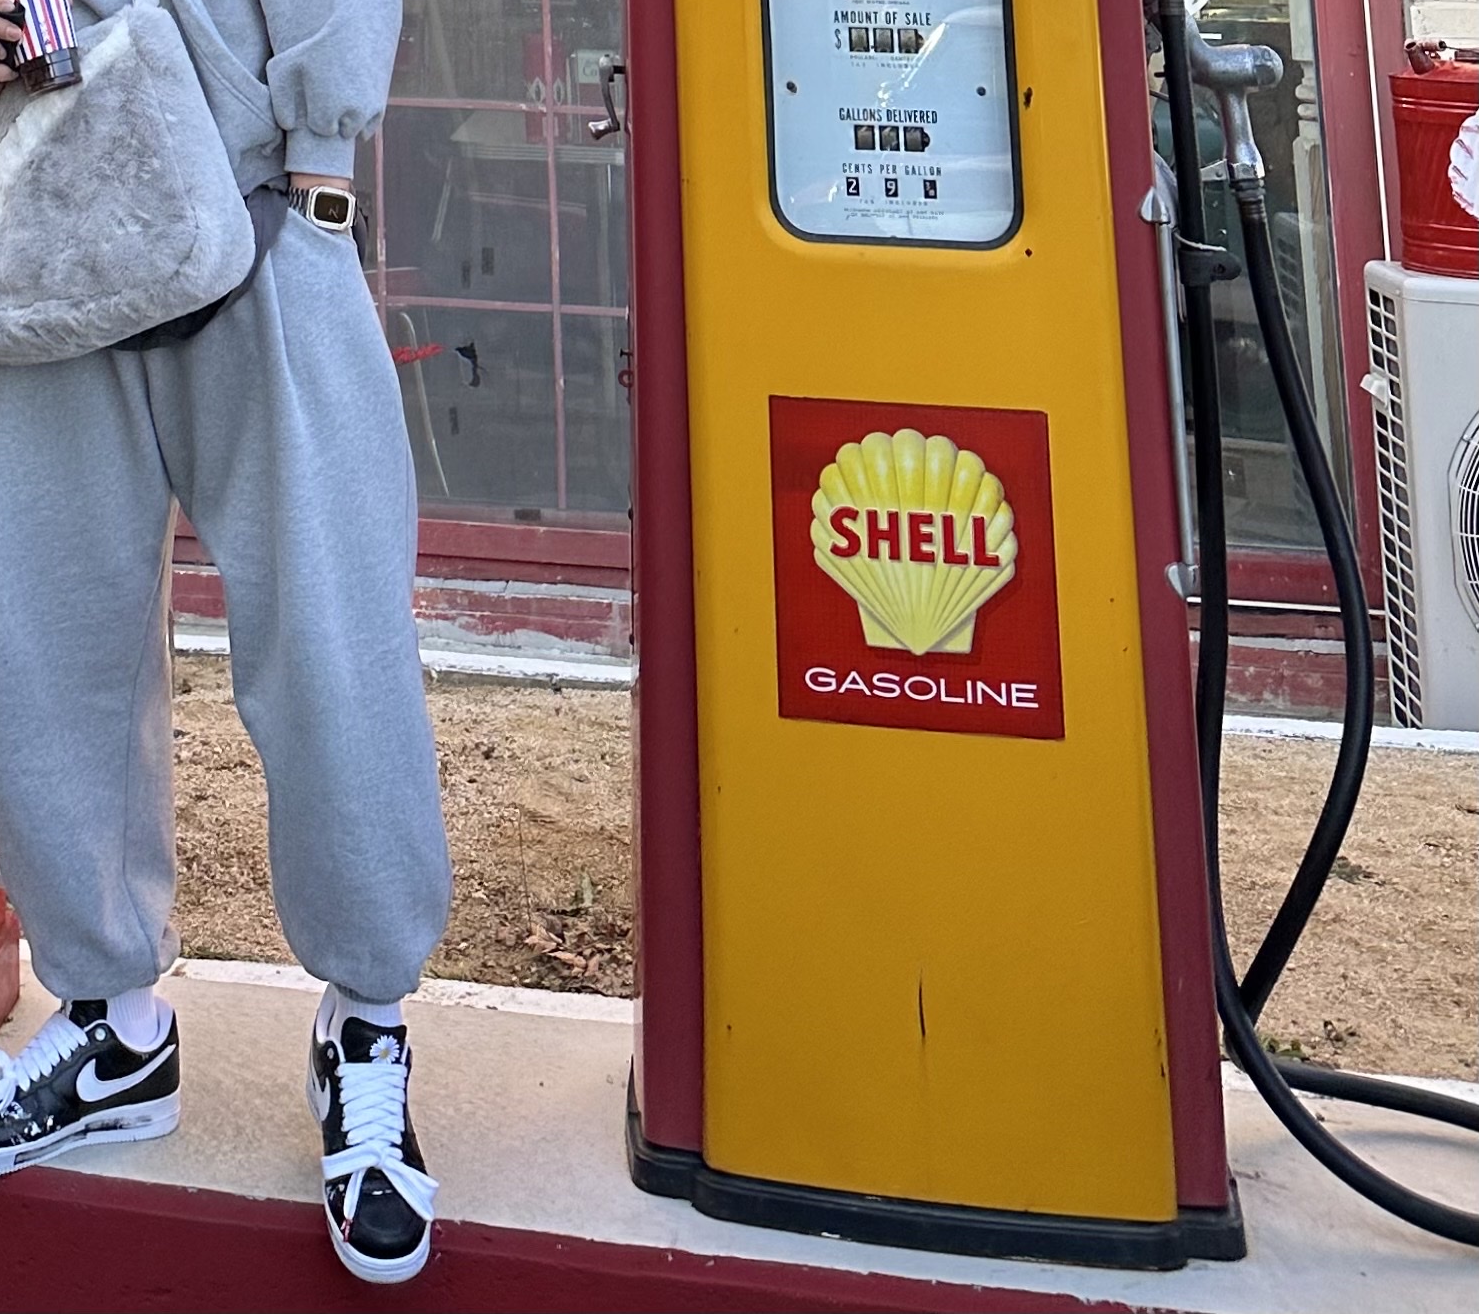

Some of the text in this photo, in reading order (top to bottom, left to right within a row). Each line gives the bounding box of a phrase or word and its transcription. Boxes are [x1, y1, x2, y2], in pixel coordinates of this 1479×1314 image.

[834, 10, 932, 27] AMOUNT OF SALE
[838, 107, 938, 124] GALLONS DELIVERED
[842, 162, 942, 177] CENTS PER GALLON
[847, 178, 896, 195] 2 9
[828, 505, 1001, 568] SHELL
[804, 666, 1040, 709] GASOLINE
